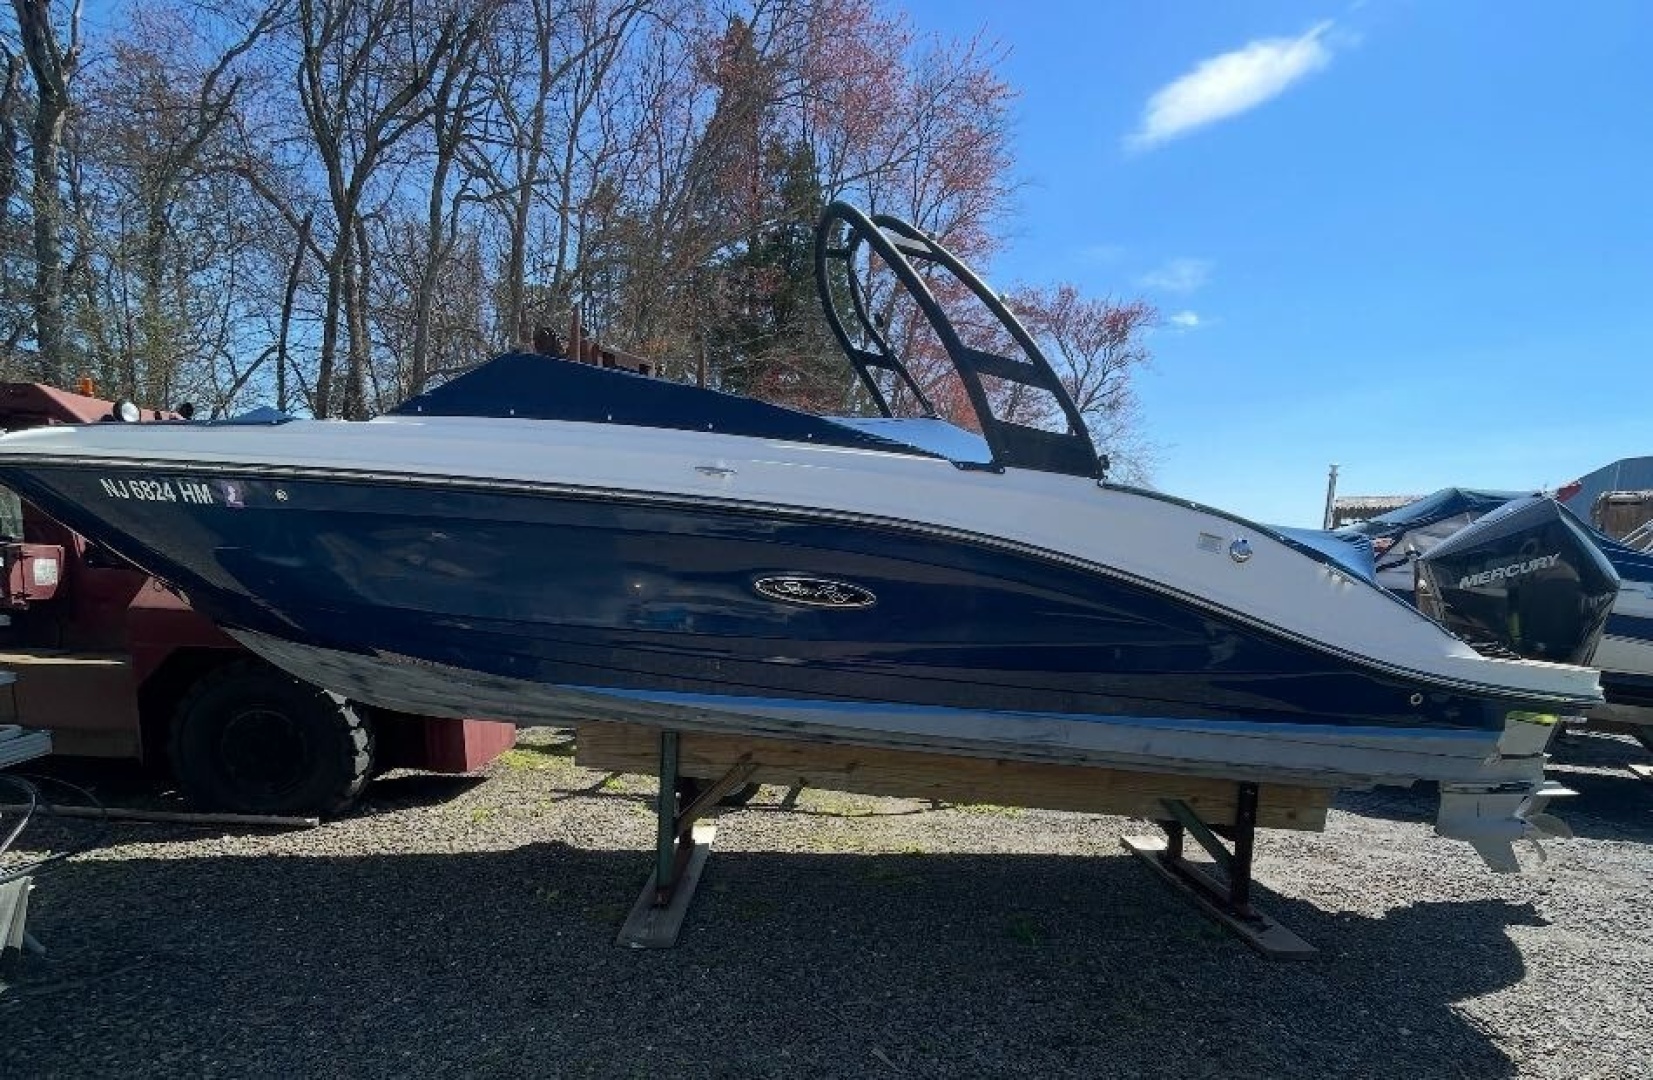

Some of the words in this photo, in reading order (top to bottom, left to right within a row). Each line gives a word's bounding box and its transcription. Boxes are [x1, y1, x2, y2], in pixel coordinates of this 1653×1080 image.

[100, 478, 130, 499] NJ
[129, 480, 177, 502] 6824
[178, 481, 214, 504] HM
[1460, 552, 1561, 589] MERCURY
